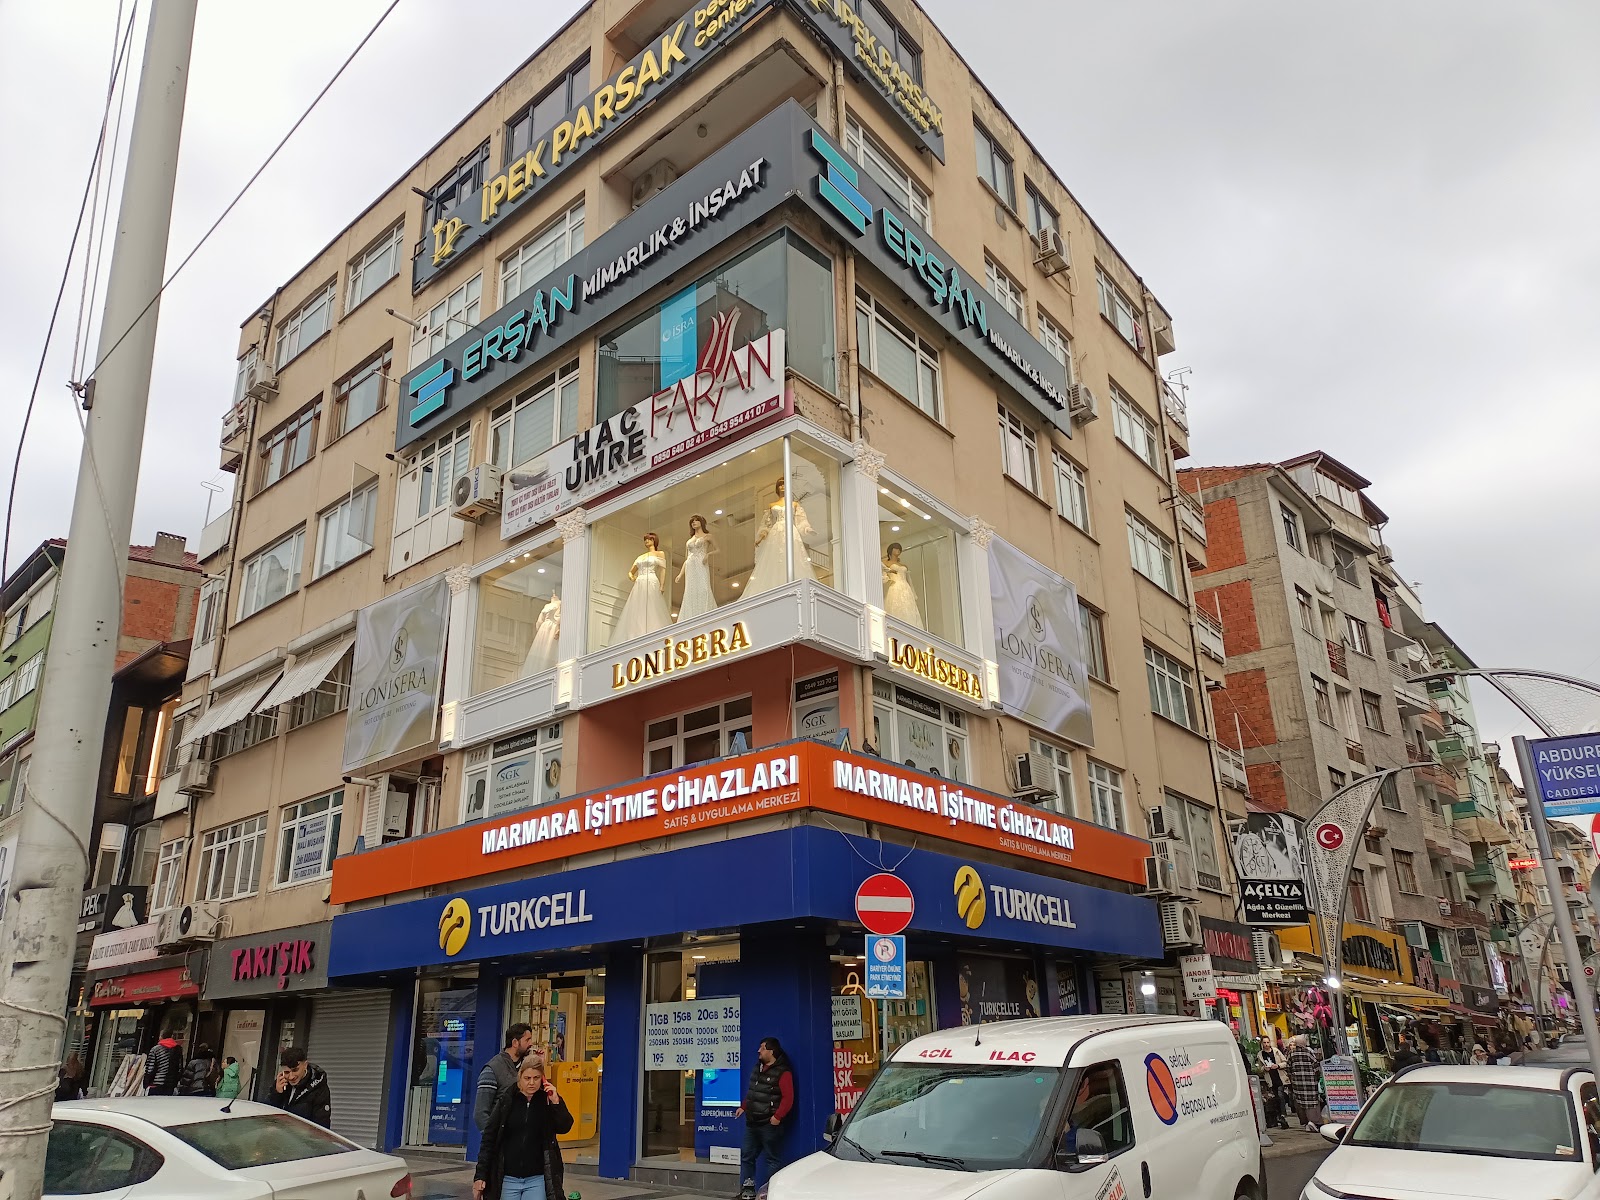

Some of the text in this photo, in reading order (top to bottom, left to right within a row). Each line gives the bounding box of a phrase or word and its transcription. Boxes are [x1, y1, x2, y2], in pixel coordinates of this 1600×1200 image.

[855, 42, 930, 134] beauty center
[878, 45, 943, 136] PARSAK
[480, 20, 687, 223] İPEK PARSAK
[581, 226, 669, 301] MİMARLIK
[669, 216, 686, 240] &
[689, 157, 765, 229] İNŞAAT
[989, 328, 1031, 377] MİMARLIK
[1031, 368, 1040, 385] &
[1039, 372, 1066, 410] İNŞAAT
[650, 332, 774, 440] FARAN
[686, 439, 695, 452] 02
[695, 434, 705, 445] 41
[709, 421, 728, 438] 0543
[729, 415, 743, 428] 954
[744, 410, 755, 421] 41
[756, 403, 766, 416] 07
[612, 622, 751, 690] LONİSERA
[888, 637, 984, 700] LONİSERA
[805, 715, 826, 729] SGK
[500, 769, 520, 782] SGK
[1547, 784, 1599, 799] CADDESİ
[482, 754, 800, 855] MARMARA İŞİTME CİHAZLARI
[664, 791, 801, 830] SATIŞ & UYGULAMA MERKEZİ
[833, 759, 1075, 850] MARMARA İŞİTME CİHAZLARI
[999, 837, 1016, 850] SATIŞ
[1244, 884, 1302, 900] AÇELYA
[478, 889, 593, 937] TURKCELL
[990, 884, 1077, 929] TURKCELL
[1247, 903, 1265, 911] Ağda
[1275, 903, 1305, 911] Güzellik
[870, 964, 887, 973] BARİYER
[870, 973, 881, 981] PARK
[650, 1013, 669, 1026] 11GB
[673, 1011, 692, 1024] 15GB
[697, 1008, 719, 1021] 20GB
[842, 1007, 858, 1017] GÖTÜR
[832, 1019, 861, 1028] MPANYAMIZ
[835, 1030, 855, 1038] BAŞLADI
[652, 1052, 739, 1063] 195 205 235 315
[919, 1047, 1037, 1063] ACİL İLAÇ
[1169, 1047, 1191, 1069] selçuk
[1175, 1075, 1193, 1089] ecza
[1181, 1095, 1206, 1118] deposu
